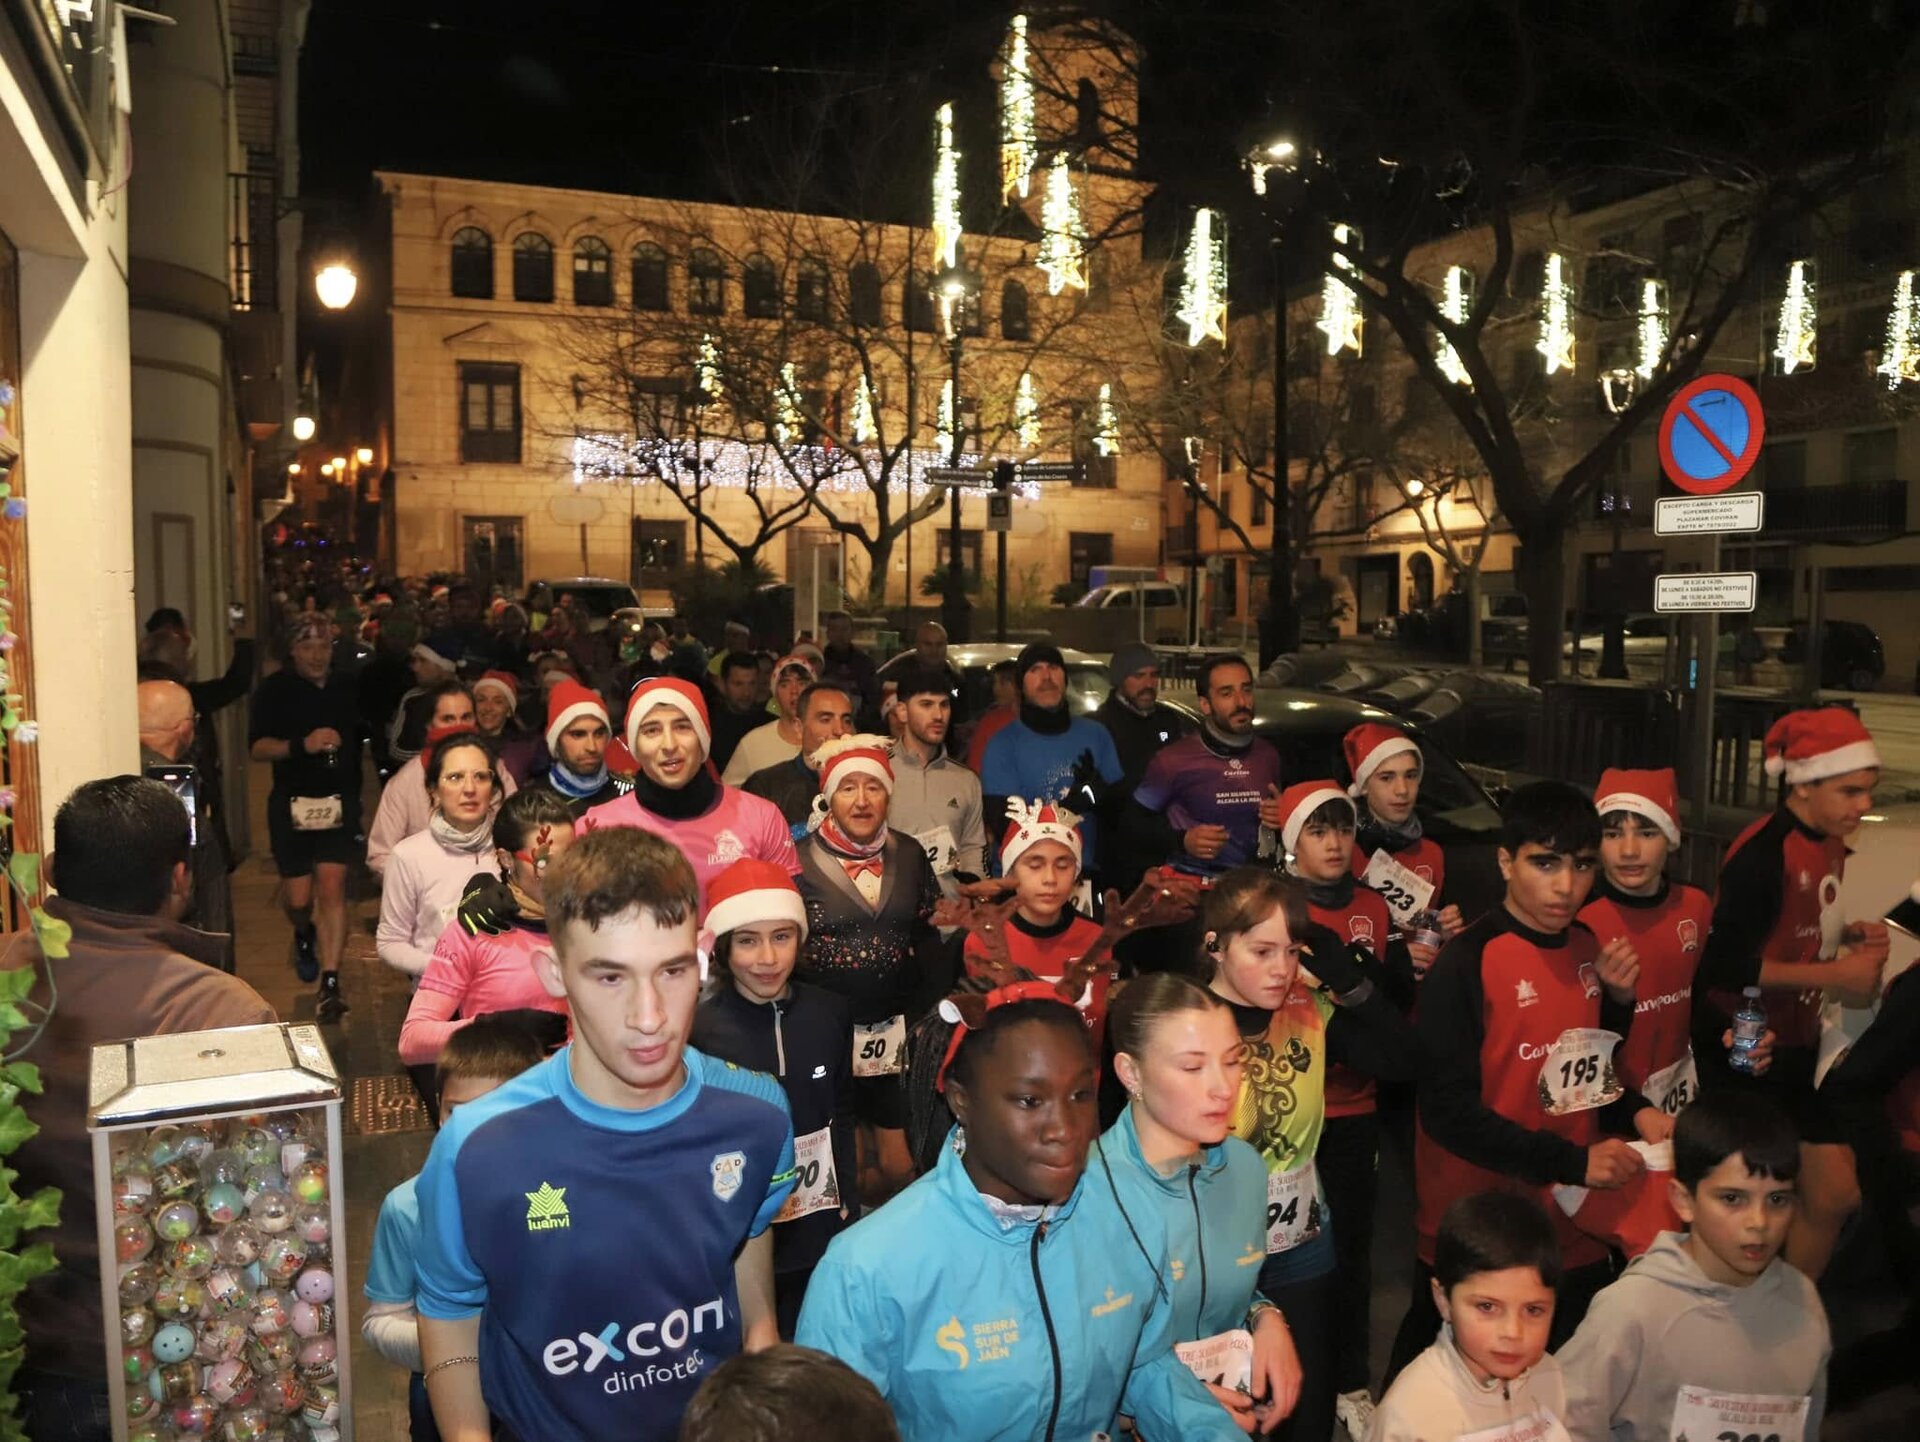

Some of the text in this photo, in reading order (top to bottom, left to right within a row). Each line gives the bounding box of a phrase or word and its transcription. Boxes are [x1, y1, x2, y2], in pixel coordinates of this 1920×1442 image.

[1683, 507, 1733, 515] SUPERMERCADO
[305, 807, 332, 820] 232
[1376, 880, 1415, 911] 223
[860, 1038, 886, 1059] 50
[1560, 1055, 1599, 1088] 195
[527, 1214, 570, 1231] luanvi
[972, 1318, 1018, 1335] SIERRA
[975, 1330, 1021, 1349] SUR DE
